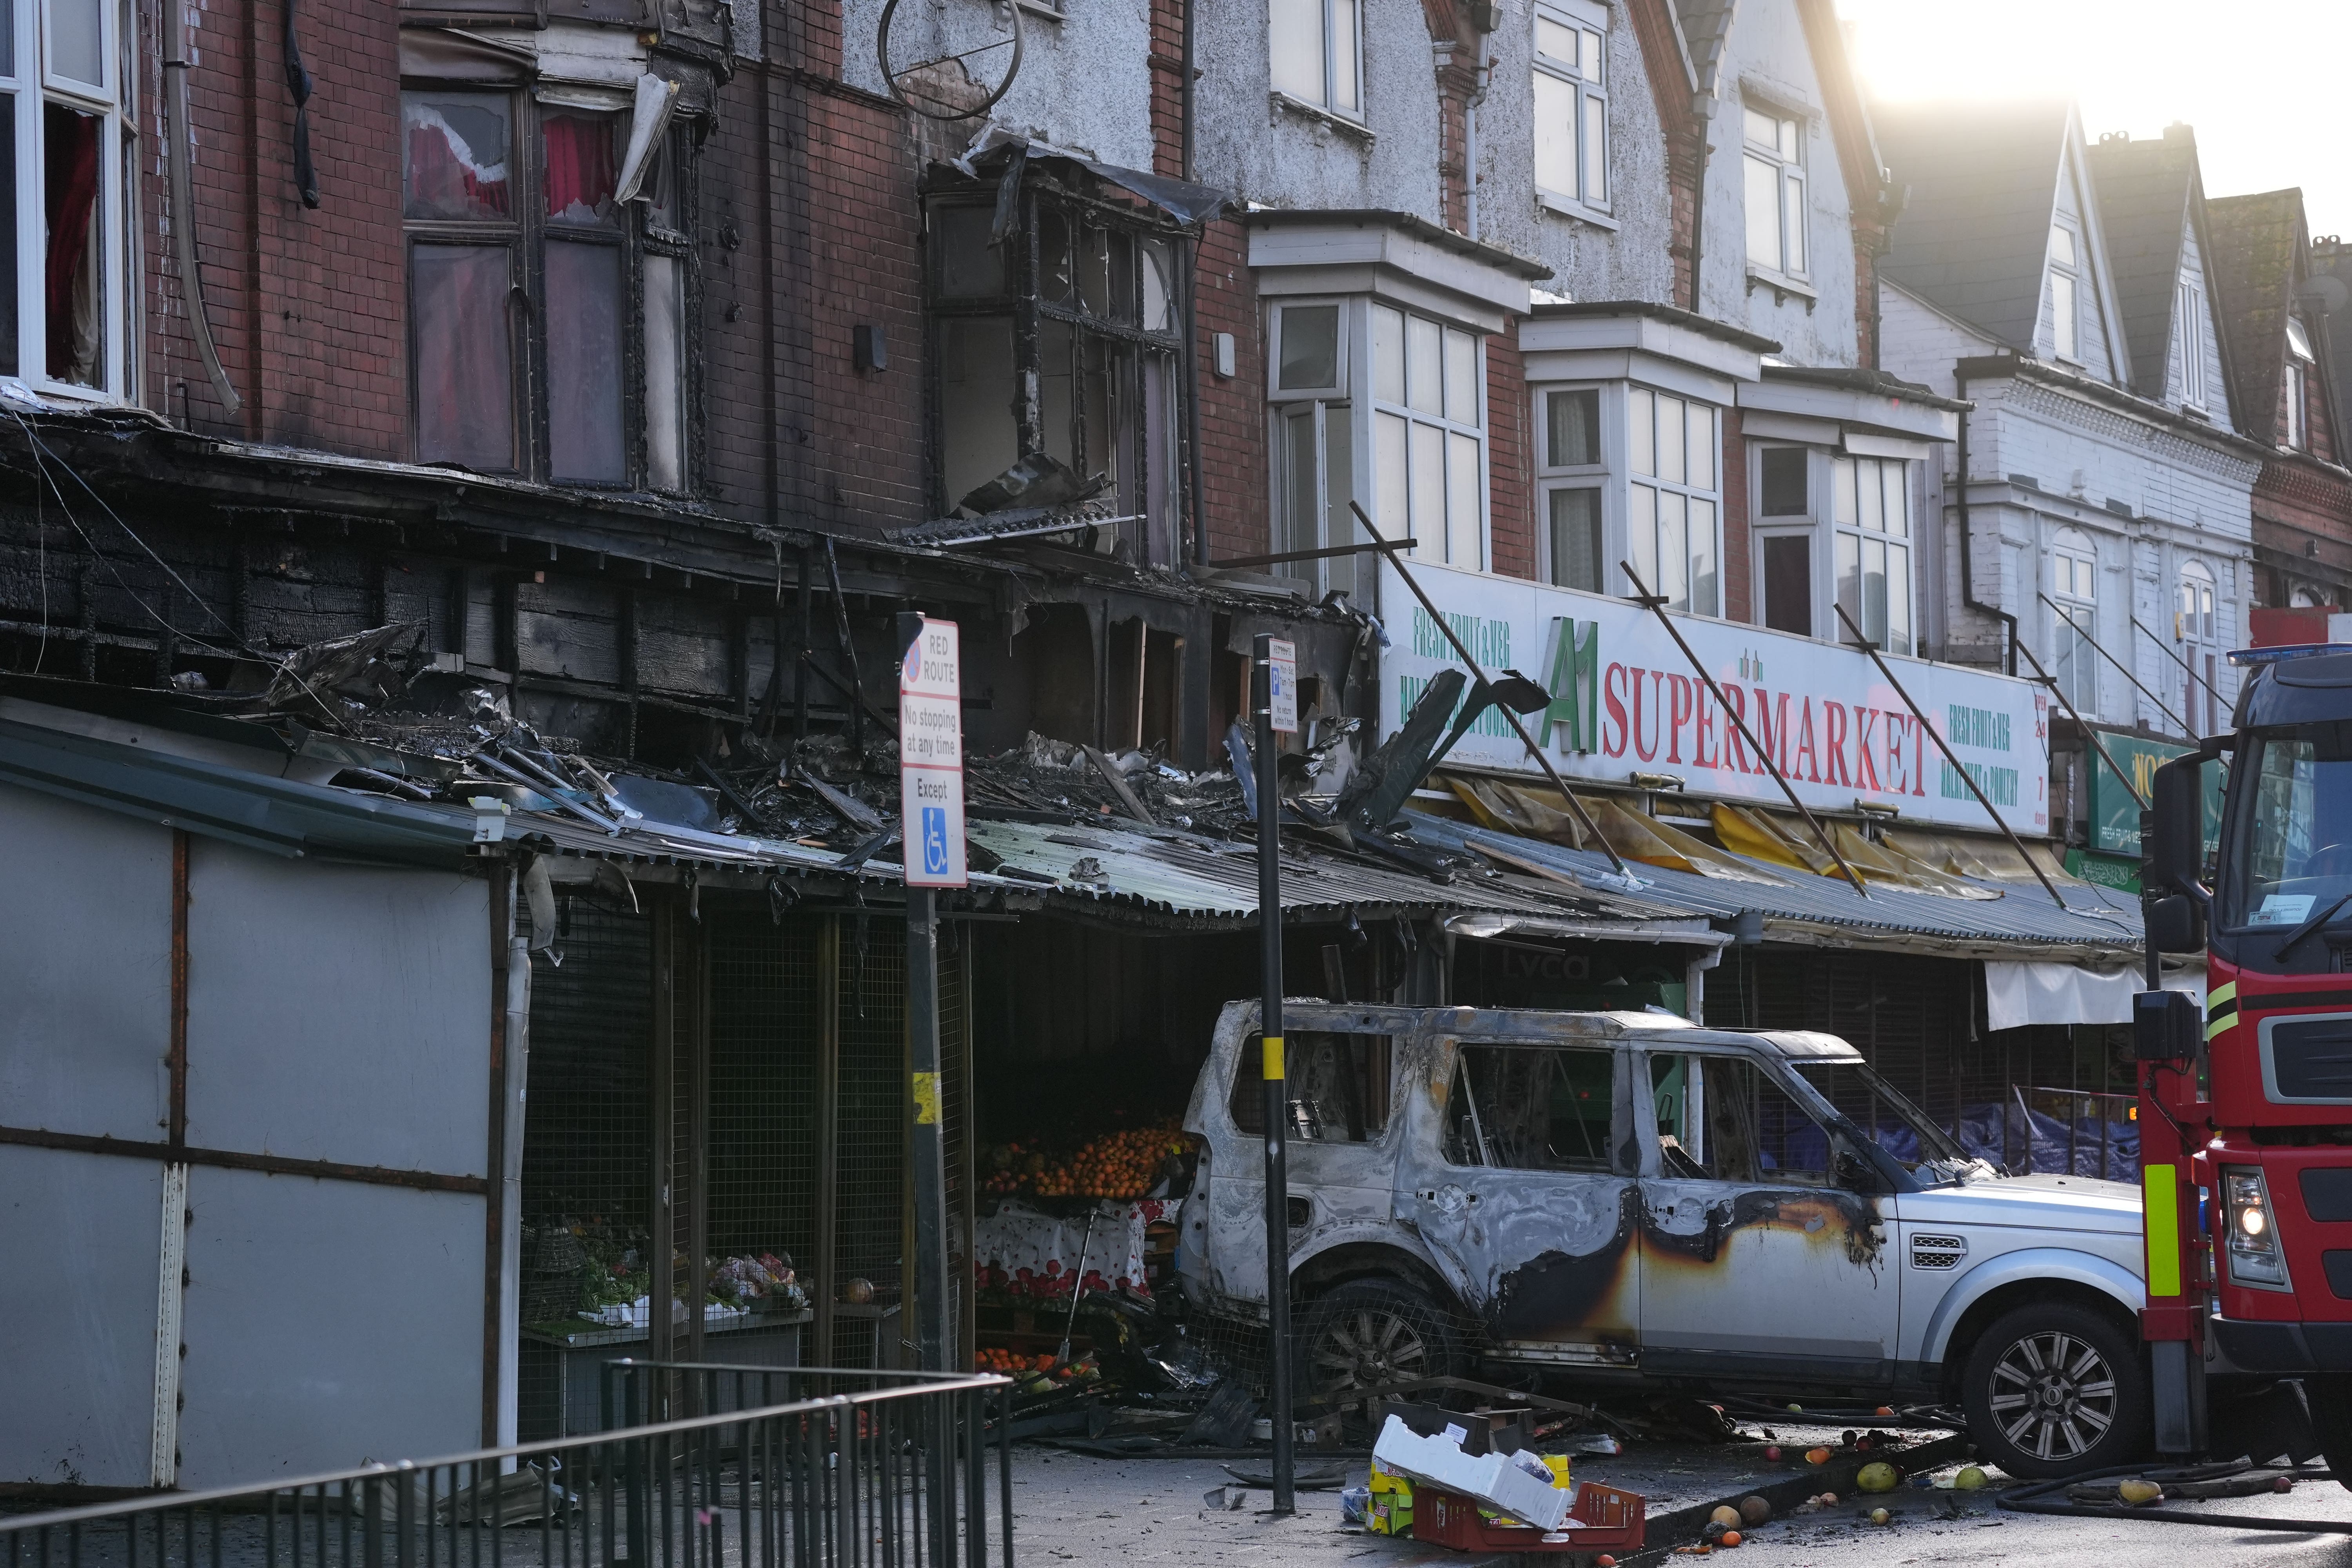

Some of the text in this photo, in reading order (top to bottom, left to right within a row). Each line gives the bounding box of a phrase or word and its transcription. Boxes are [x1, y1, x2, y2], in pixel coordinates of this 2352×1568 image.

[930, 635, 948, 655] RED
[1413, 606, 1509, 670] FRESH FRUIT & VEG
[1281, 646, 1292, 656] ROUTE
[924, 660, 955, 683] ROUTE
[1535, 616, 1598, 755] A1
[1277, 704, 1291, 715] No return
[2035, 694, 2046, 711] OPEN
[905, 704, 956, 733] No stopping
[1275, 717, 1284, 725] within
[1603, 662, 1930, 797] SUPERMARKET
[1949, 704, 2010, 751] FRESH FRUIT & VEG
[2036, 720, 2045, 739] 24
[907, 733, 955, 757] at any time
[1941, 759, 2018, 807] HALAL MEAT & POULTRY
[2134, 753, 2174, 799] NO
[917, 778, 947, 802] Except
[2038, 776, 2043, 801] 7
[2035, 811, 2046, 826] days
